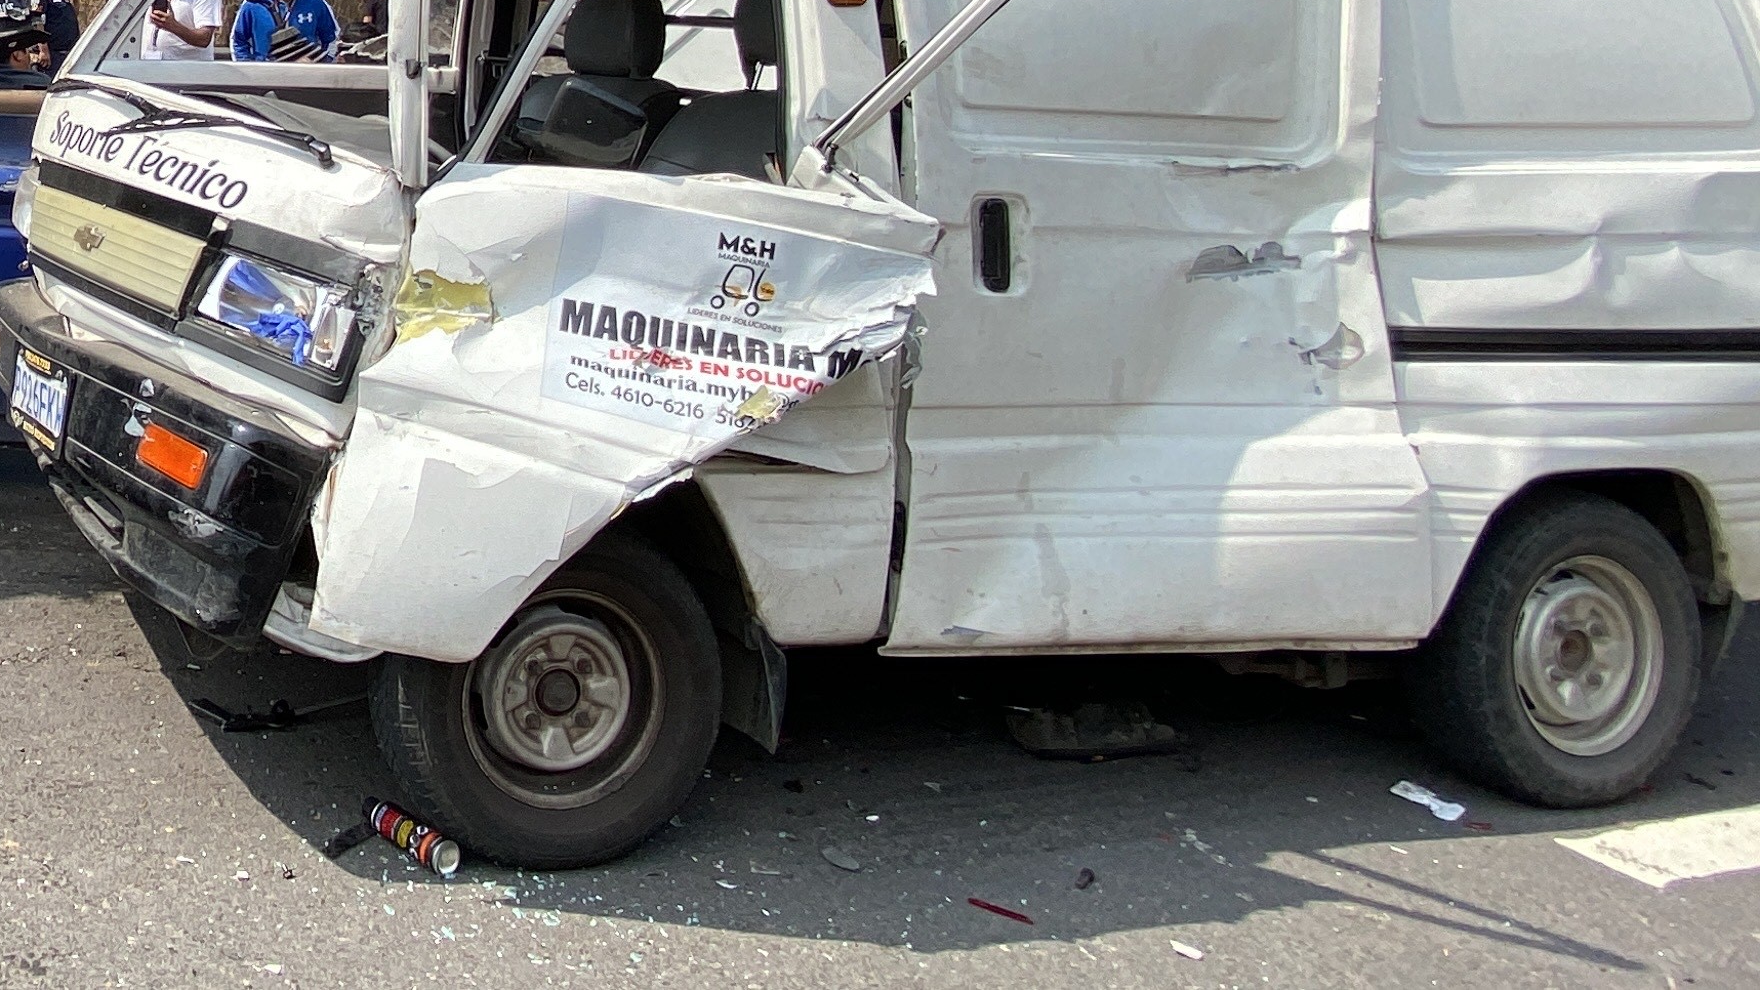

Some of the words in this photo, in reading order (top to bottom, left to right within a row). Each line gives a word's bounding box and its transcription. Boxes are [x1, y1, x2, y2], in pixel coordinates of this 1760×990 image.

[49, 110, 123, 162] Soporte
[718, 232, 776, 260] M&H
[718, 252, 771, 269] MAQUINARIA
[559, 298, 817, 372] MAQUINARIA
[719, 313, 731, 322] EN
[731, 316, 783, 333] SOLUCIONES
[699, 360, 730, 377] EN
[565, 371, 605, 397] Cels.
[611, 385, 705, 419] 4610-6216
